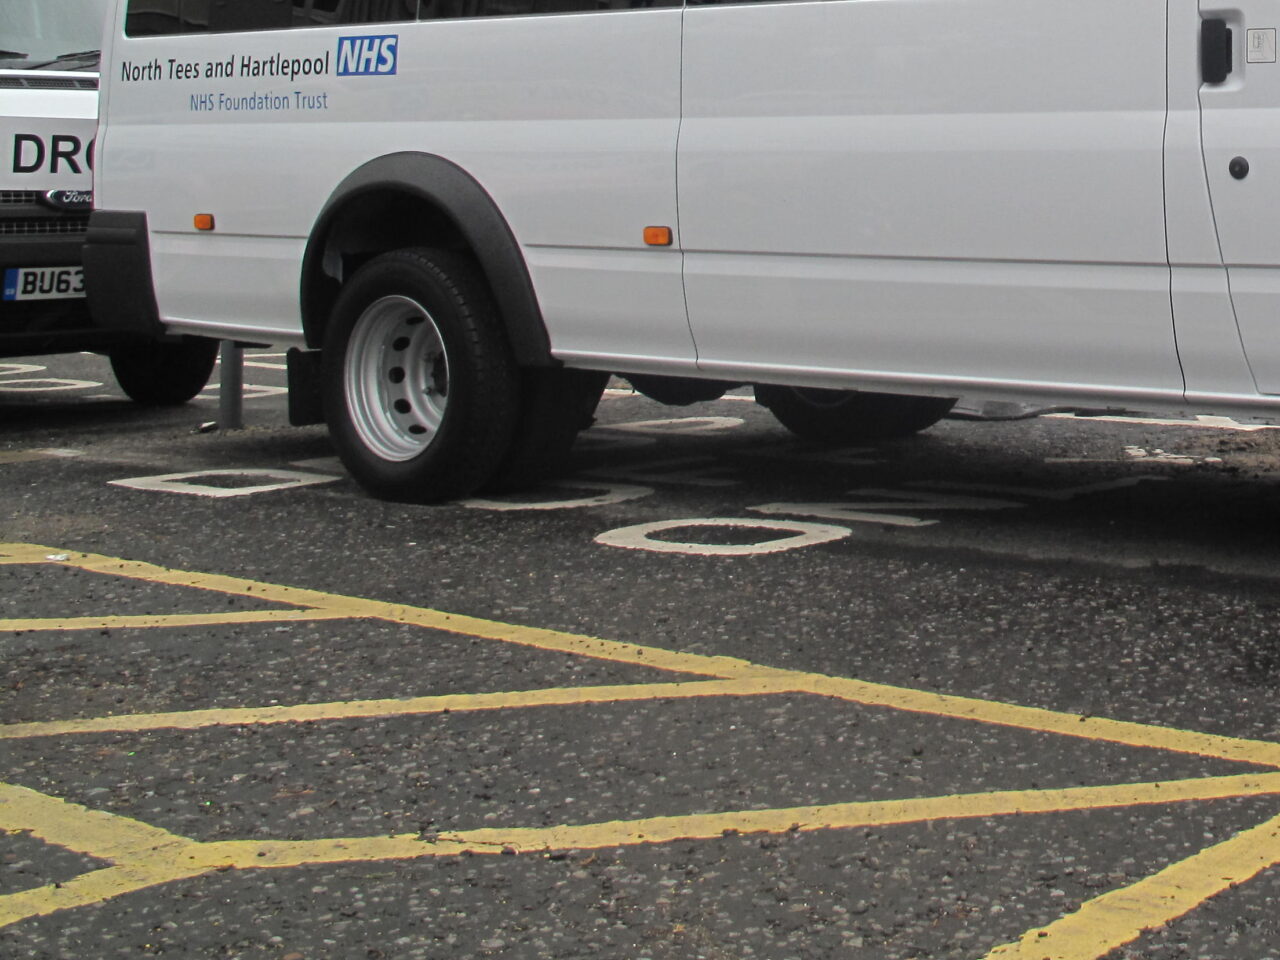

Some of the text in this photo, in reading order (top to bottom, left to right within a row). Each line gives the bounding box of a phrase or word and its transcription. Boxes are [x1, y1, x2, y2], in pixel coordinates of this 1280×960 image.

[121, 37, 397, 82] North Tees and Hartlepool NHS
[190, 91, 328, 112] NHS Foundation Trust
[12, 133, 95, 174] DR
[21, 269, 86, 295] BU63
